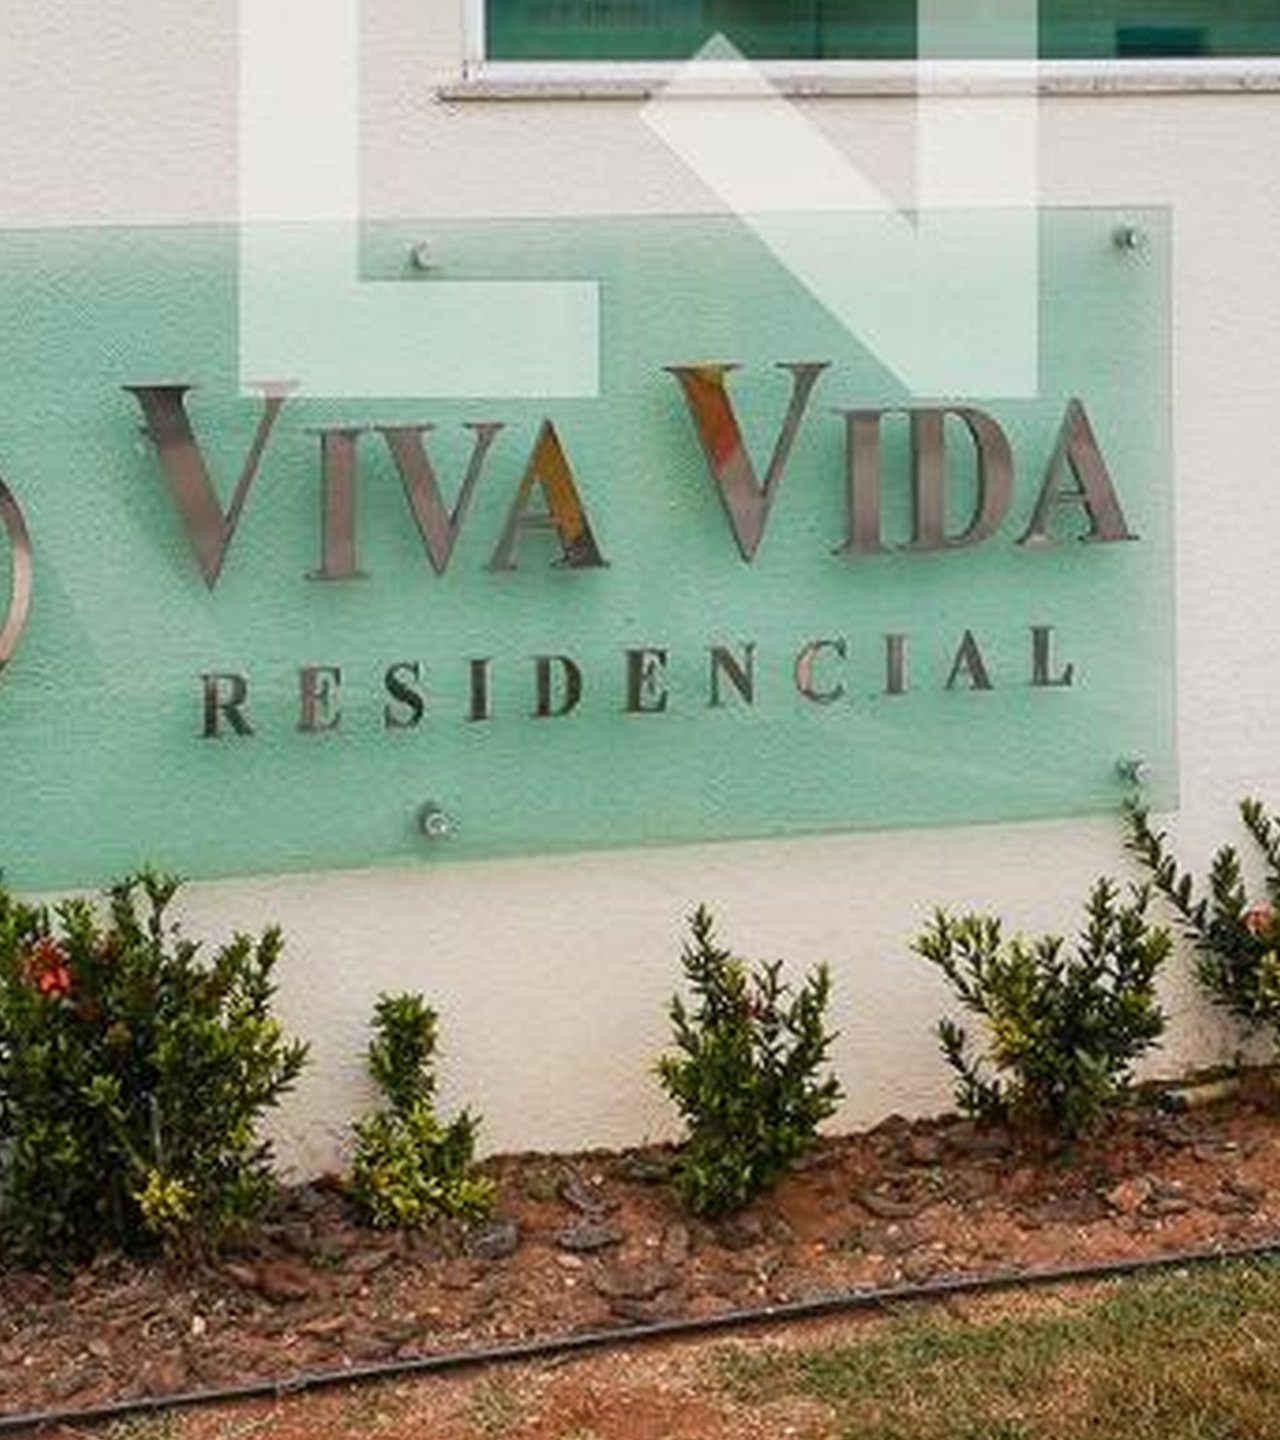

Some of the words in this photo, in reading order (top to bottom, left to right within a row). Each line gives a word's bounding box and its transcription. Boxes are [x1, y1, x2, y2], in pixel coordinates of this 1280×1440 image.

[121, 378, 611, 591] VIVA
[661, 360, 1140, 563] VIDA
[197, 626, 1074, 740] RESIDENCIAL
